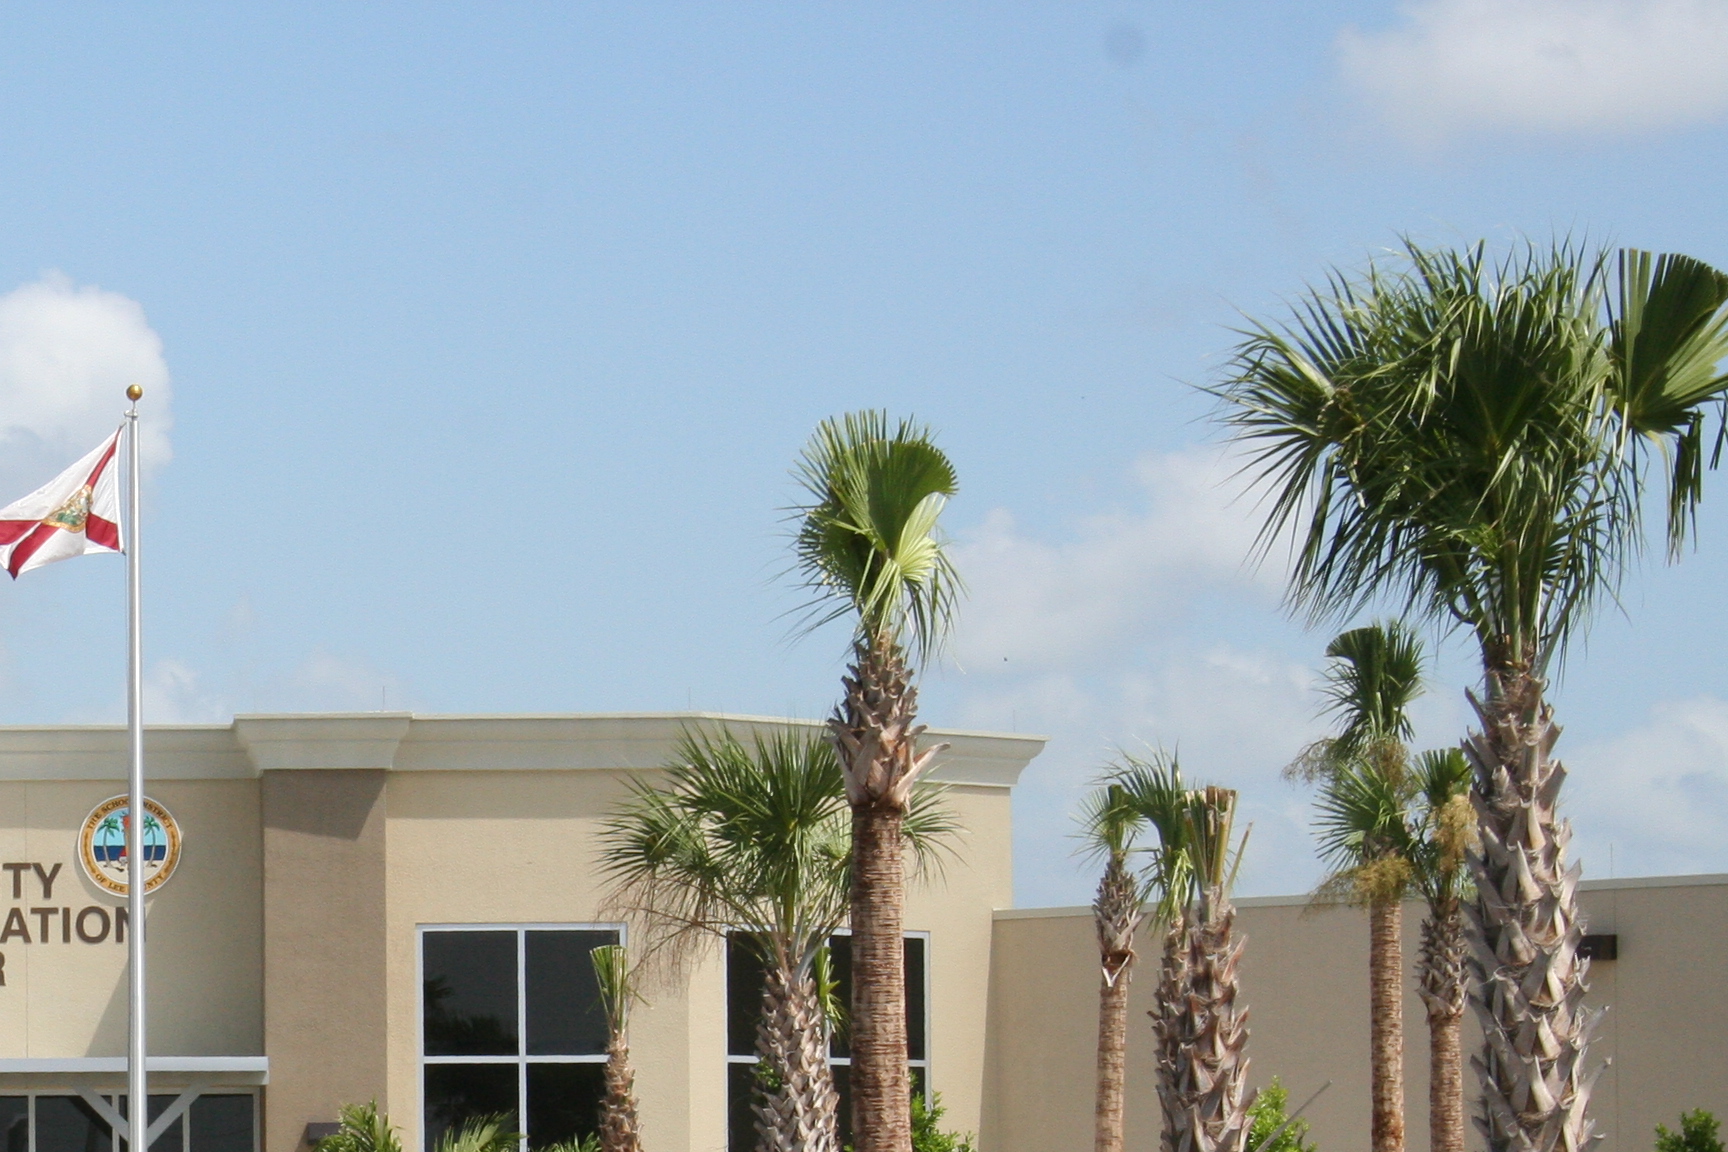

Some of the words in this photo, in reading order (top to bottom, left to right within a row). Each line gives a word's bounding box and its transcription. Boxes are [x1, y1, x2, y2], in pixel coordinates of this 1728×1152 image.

[87, 813, 100, 830] THE
[102, 799, 129, 814] SCHO
[143, 801, 172, 829] ISTRICT
[95, 873, 107, 884] OF
[108, 882, 126, 892] LEE
